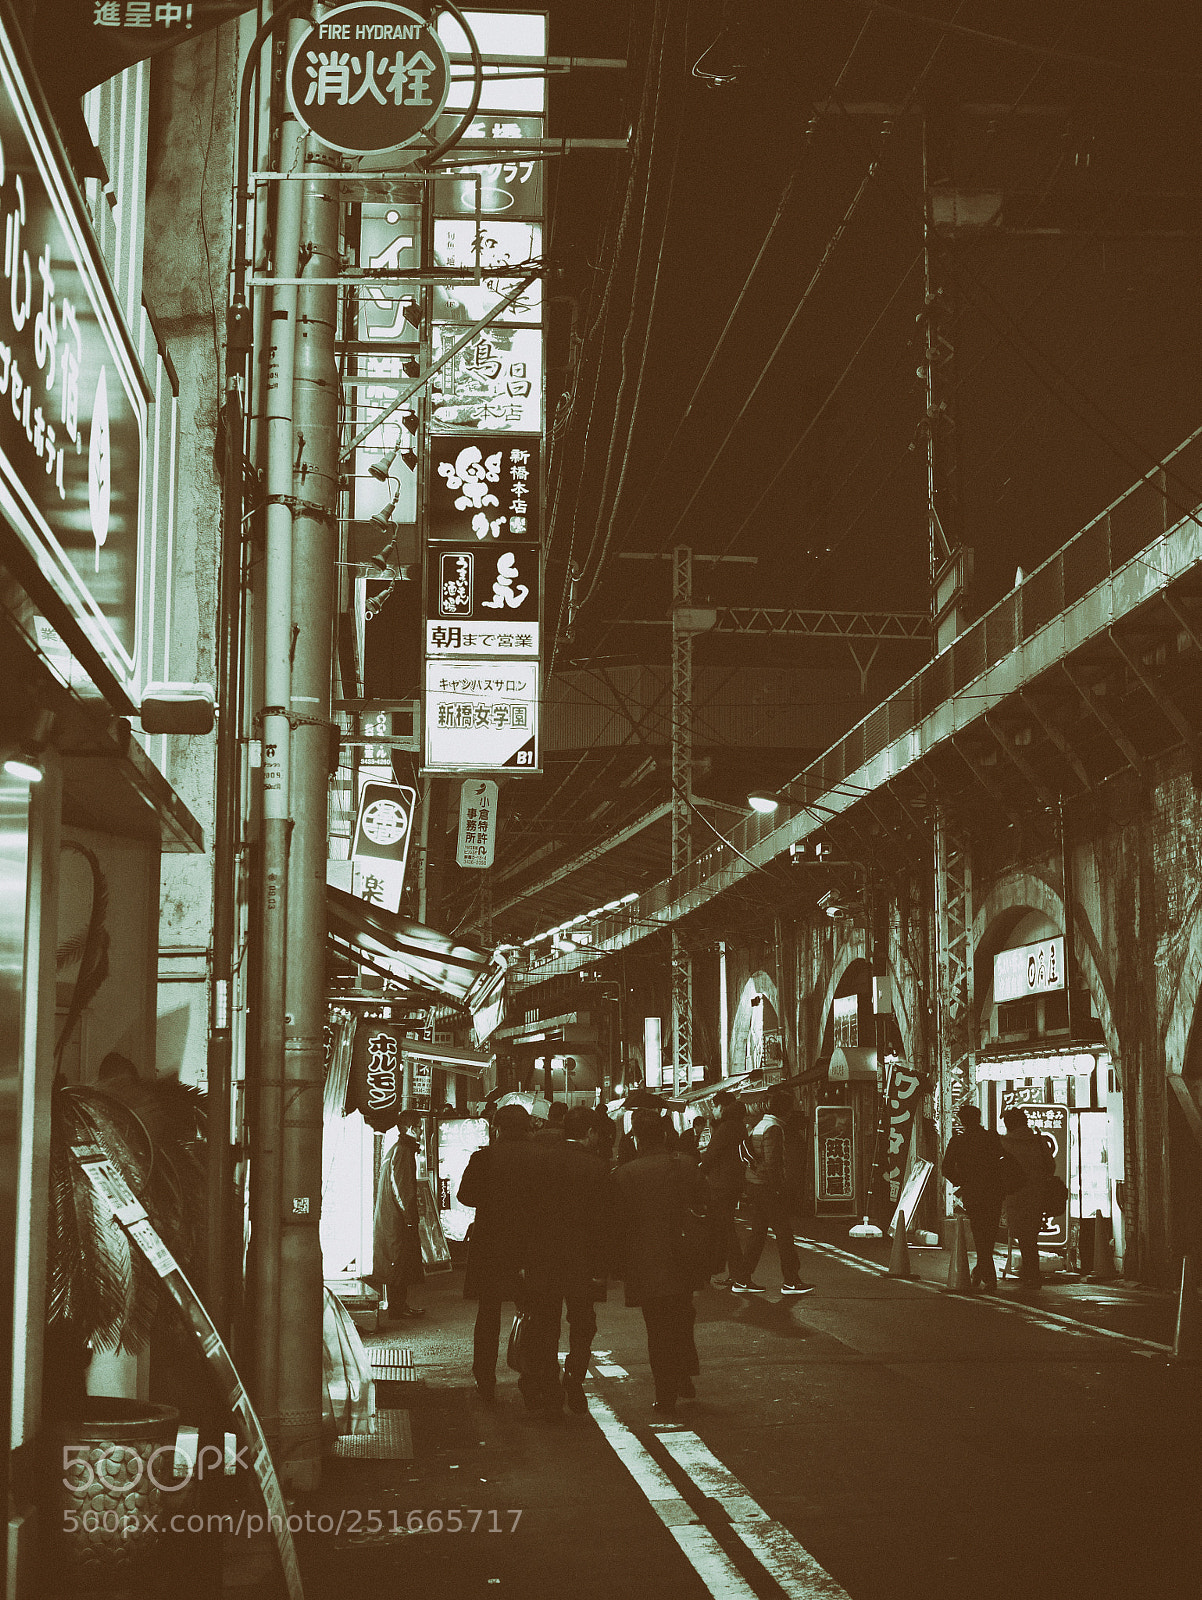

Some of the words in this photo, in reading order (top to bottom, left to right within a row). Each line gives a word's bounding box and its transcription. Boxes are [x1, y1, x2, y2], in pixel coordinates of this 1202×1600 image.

[93, 1, 193, 29] 進呈中!
[319, 24, 351, 40] FIRE
[355, 24, 422, 40] HYDRANT
[304, 50, 436, 106] 消火栓
[509, 448, 531, 514] 新橋本店
[431, 625, 533, 649] 朝まで営業
[438, 703, 528, 729] 新橋女学園
[516, 751, 533, 765] B1
[465, 807, 477, 844] 事務所
[477, 796, 490, 845] 小倉特許
